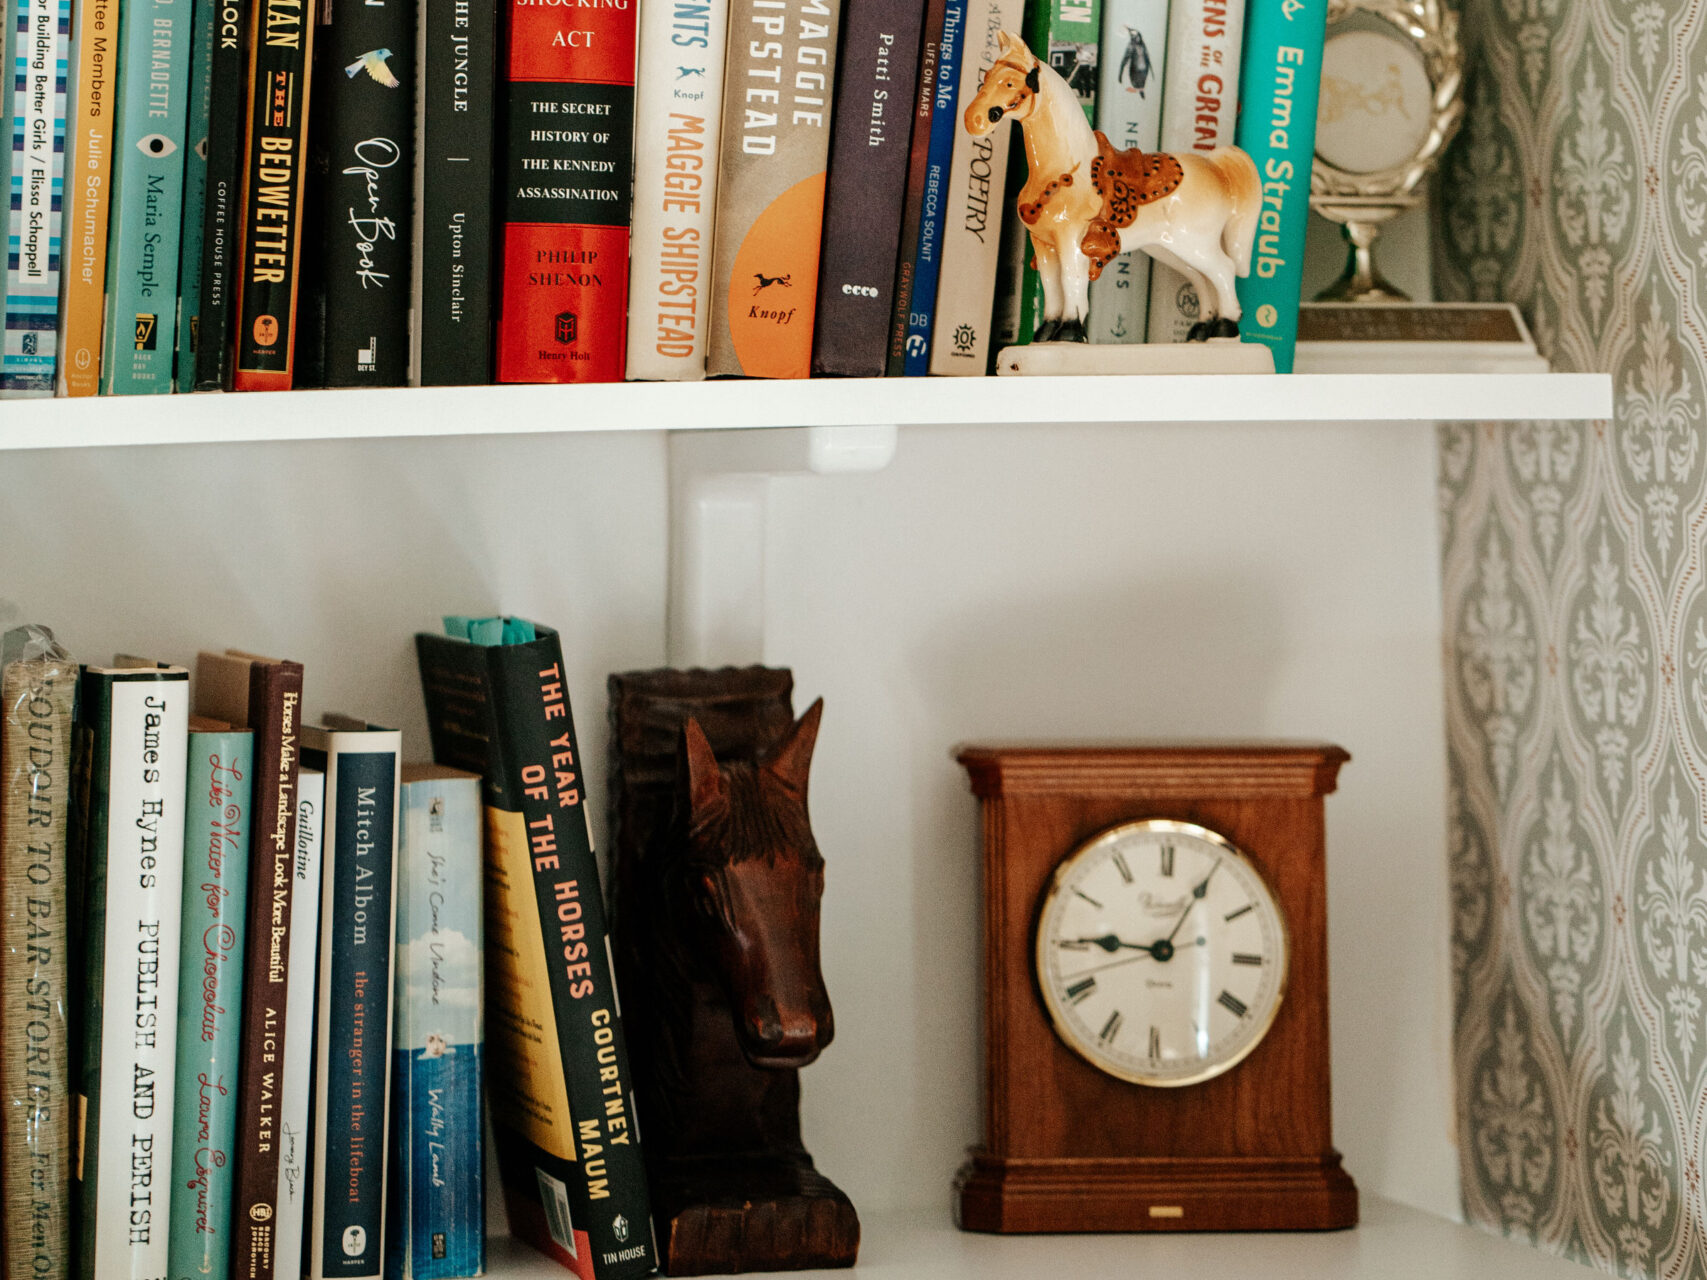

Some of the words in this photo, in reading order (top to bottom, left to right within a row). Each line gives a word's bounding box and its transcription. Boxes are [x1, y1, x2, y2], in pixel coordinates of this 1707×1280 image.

[32, 15, 50, 70] Building
[552, 30, 595, 48] ACT
[875, 32, 894, 82] Patti
[926, 42, 936, 65] LIFE
[939, 9, 960, 61] Things
[34, 74, 49, 116] Better
[89, 36, 107, 117] Members
[451, 35, 469, 113] JUNGLE
[673, 89, 704, 102] Knopf
[924, 68, 933, 83] ON
[937, 83, 952, 109] Me
[939, 64, 950, 81] to
[1269, 45, 1304, 149] Emma
[531, 102, 558, 113] THE
[562, 102, 611, 115] SECRET
[868, 88, 888, 147] Smith
[918, 87, 929, 118] MARS
[33, 118, 47, 150] Girls
[87, 128, 103, 169] Julie
[530, 131, 589, 143] HISTORY
[593, 132, 610, 144] OF
[30, 168, 45, 206] Elissa
[522, 158, 549, 170] THE
[553, 159, 616, 173] KENNEDY
[662, 112, 706, 214] MAGGIE
[145, 175, 165, 226] Maria
[216, 181, 227, 224] COFFEE
[253, 136, 293, 284] BEDWETTER
[517, 187, 619, 201] ASSASSINATION
[924, 164, 940, 218] REBECCA
[25, 211, 43, 277] Schappell
[82, 175, 101, 285] Schumacher
[449, 212, 465, 258] Upton
[921, 220, 935, 262] SOLNIT
[1256, 157, 1294, 279] Straub
[136, 233, 161, 298] Semple
[214, 227, 225, 268] HOUSE
[537, 250, 599, 264] PHILIP
[211, 272, 222, 307] PRESS
[451, 264, 465, 323] Sinclair
[528, 273, 603, 287] SHENON
[655, 226, 701, 359] SHIPSTEAD
[748, 305, 797, 324] Knopf
[281, 692, 298, 734] Horses
[539, 662, 567, 721] THE
[142, 696, 166, 784] James
[279, 734, 296, 773] Make
[279, 773, 286, 782] a
[521, 764, 550, 802] OF
[549, 732, 579, 809] YEAR
[270, 783, 293, 851] Landscape
[296, 800, 315, 880] Guillotine
[355, 786, 376, 857] Mitch
[136, 798, 163, 889] Hynes
[529, 814, 560, 873] THE
[273, 853, 289, 887] Look
[271, 888, 287, 923] More
[354, 866, 375, 946] Albom
[268, 923, 286, 983] Beautiful
[554, 880, 595, 1000] HORSES
[134, 920, 160, 1049] PUBLISH
[353, 971, 369, 998] the
[263, 1007, 277, 1063] ALICE
[349, 1006, 366, 1078] stranger
[132, 1063, 155, 1120] AND
[352, 1082, 363, 1098] in
[591, 1008, 630, 1146] COURTNEY
[258, 1072, 275, 1153] WALKER
[351, 1103, 365, 1131] the
[350, 1137, 366, 1203] lifeboat
[578, 1119, 611, 1200] MAUM
[129, 1134, 153, 1247] PERISH
